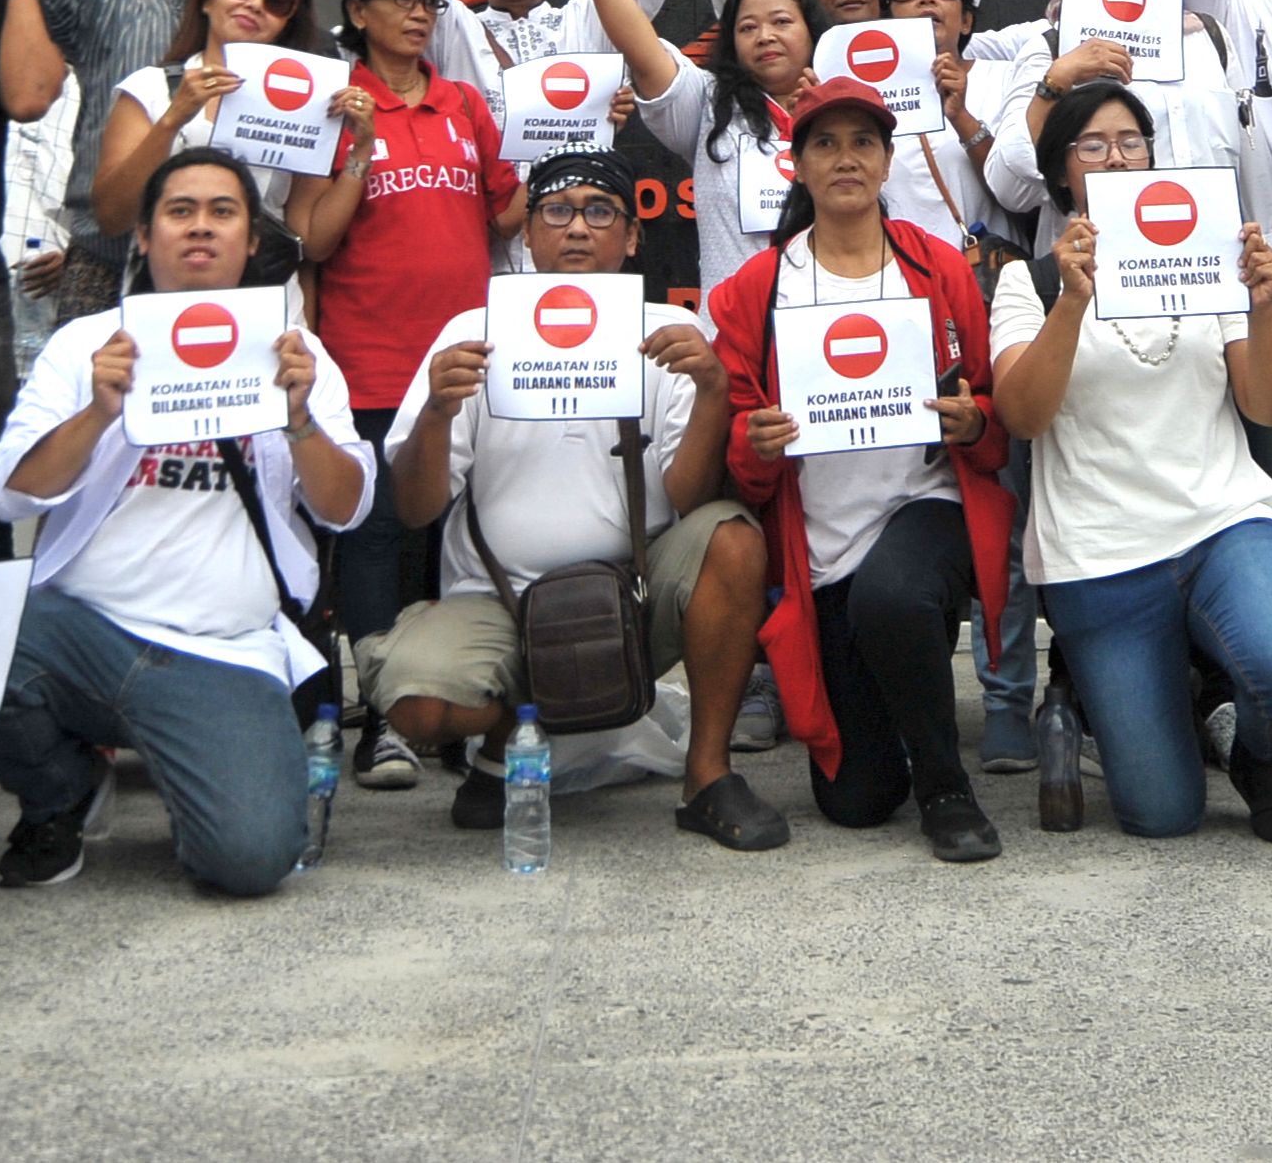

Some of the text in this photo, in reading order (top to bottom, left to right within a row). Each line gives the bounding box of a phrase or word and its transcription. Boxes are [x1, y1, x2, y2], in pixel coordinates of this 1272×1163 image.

[1080, 27, 1161, 45] KOMBATAN ISIS
[901, 86, 920, 97] ISIS
[886, 99, 921, 114] MASUK
[238, 114, 321, 136] KOMBATAN ISIS
[524, 118, 597, 128] KOMBATAN ISIS
[235, 127, 316, 149] DILARANG MASUK
[522, 130, 595, 141] DILARANG MASUK
[366, 165, 478, 201] BREGADA
[1119, 255, 1220, 270] KOMBATAN ISIS
[1121, 271, 1221, 288] DILARANG MASUK
[512, 360, 617, 372] KOMBATAN ISIS
[150, 376, 261, 395] KOMBATAN ISIS
[513, 376, 616, 390] DILARANG MASUK
[152, 393, 259, 414] DILARANG MASUK
[807, 386, 912, 406] KOMBATAN ISIS
[809, 402, 912, 424] DILARANG MASUK
